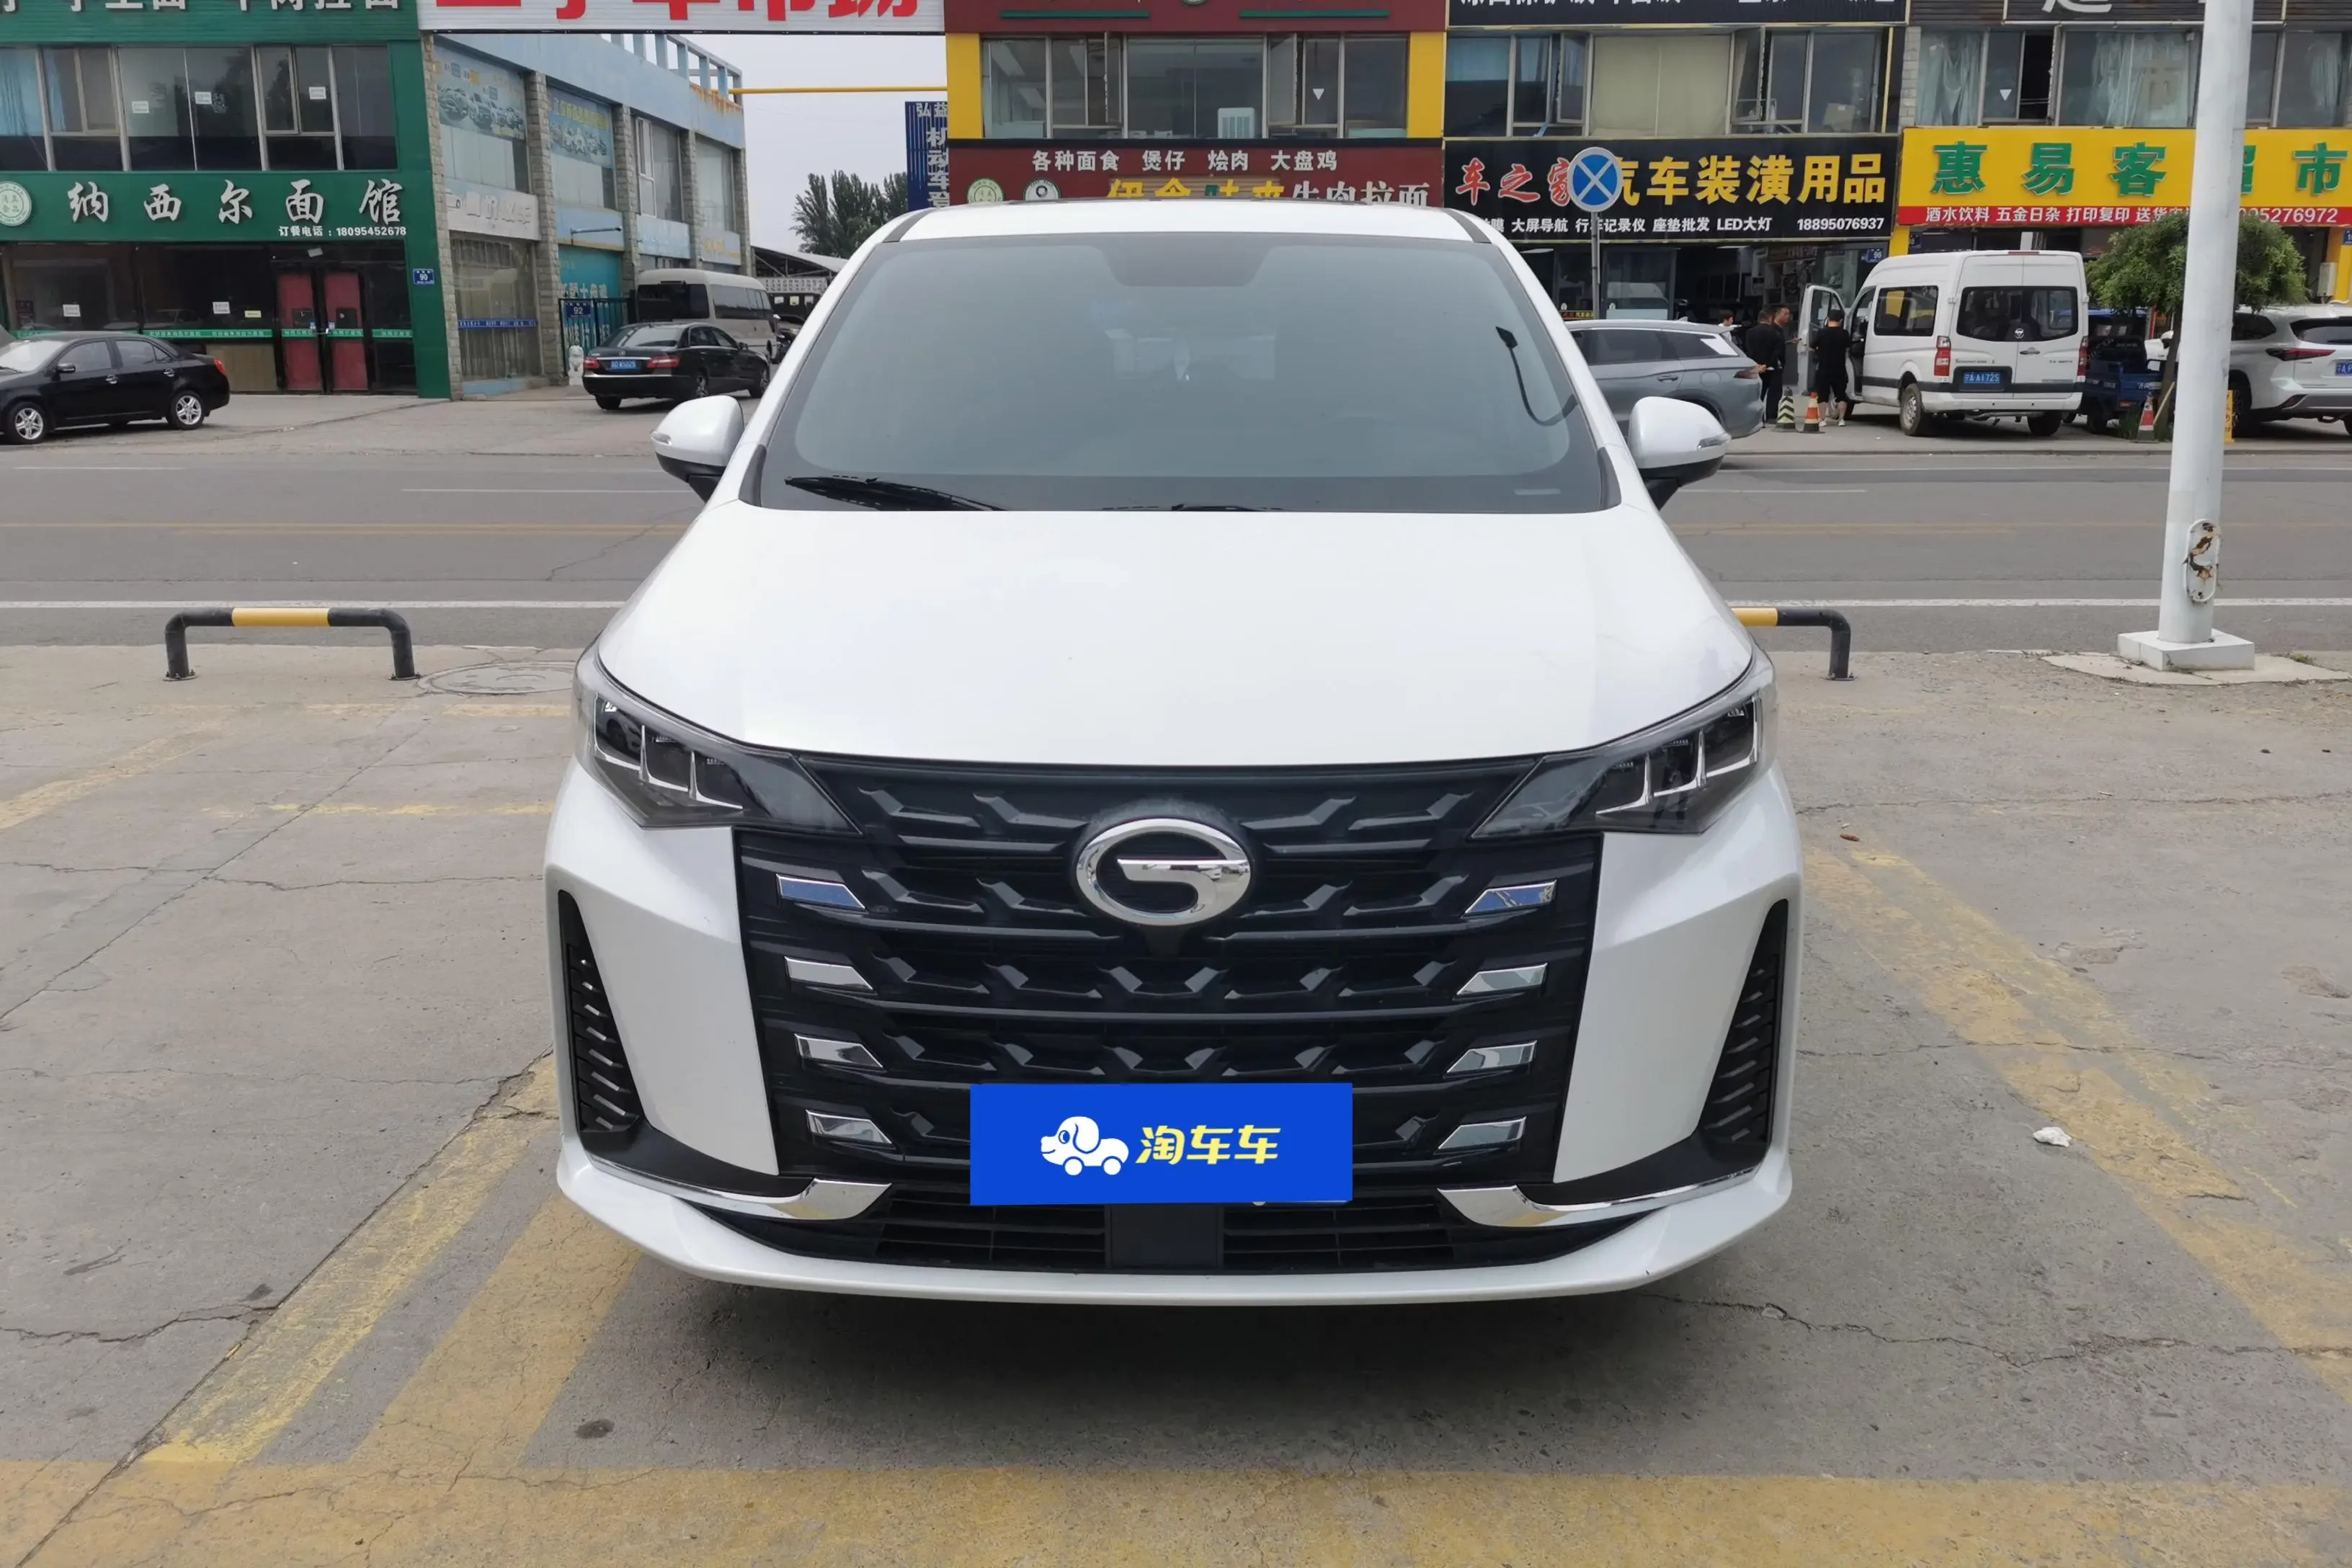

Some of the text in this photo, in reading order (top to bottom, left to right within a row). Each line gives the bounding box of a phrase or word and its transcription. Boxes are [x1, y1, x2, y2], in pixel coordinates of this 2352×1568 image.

[916, 102, 948, 117] 弘益
[1032, 150, 1337, 172] 各种面食 煲仔 烩肉 大盘鸡
[67, 179, 404, 226] 纳西尔面馆
[1925, 207, 1990, 223] 酒水饮料
[1995, 207, 2061, 223] 五金日杂
[2066, 207, 2129, 223] 打印复印
[1511, 218, 1568, 233] 大屏导航
[1652, 217, 1710, 232] 座垫批发
[1716, 217, 1773, 231] LED大灯
[1797, 218, 1885, 231] 18895076937
